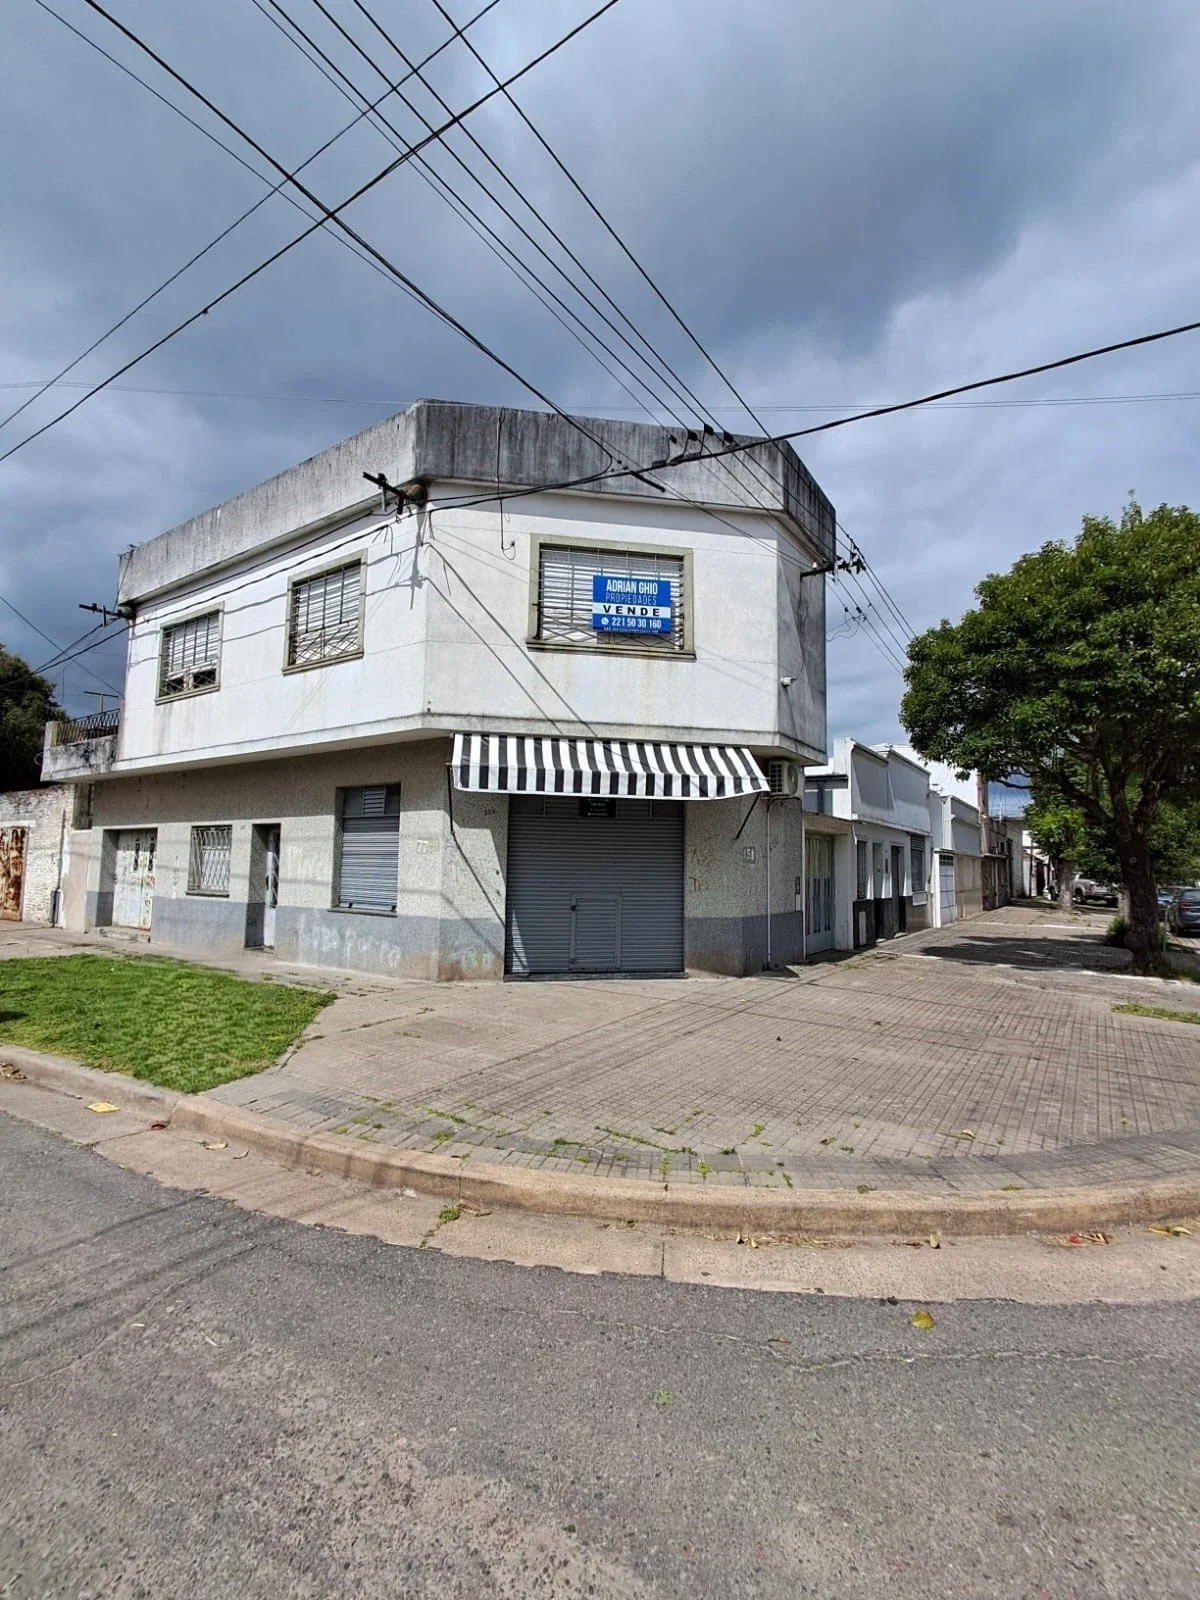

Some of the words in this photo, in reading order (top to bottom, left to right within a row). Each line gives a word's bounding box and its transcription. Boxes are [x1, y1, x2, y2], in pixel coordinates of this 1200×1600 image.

[606, 579, 637, 593] ADRIAN
[638, 582, 658, 595] GHIO
[605, 593, 657, 605] PROPIEDADES
[603, 605, 660, 616] VENDE
[611, 617, 625, 627] 221
[637, 619, 646, 628] 30
[649, 619, 662, 629] 160
